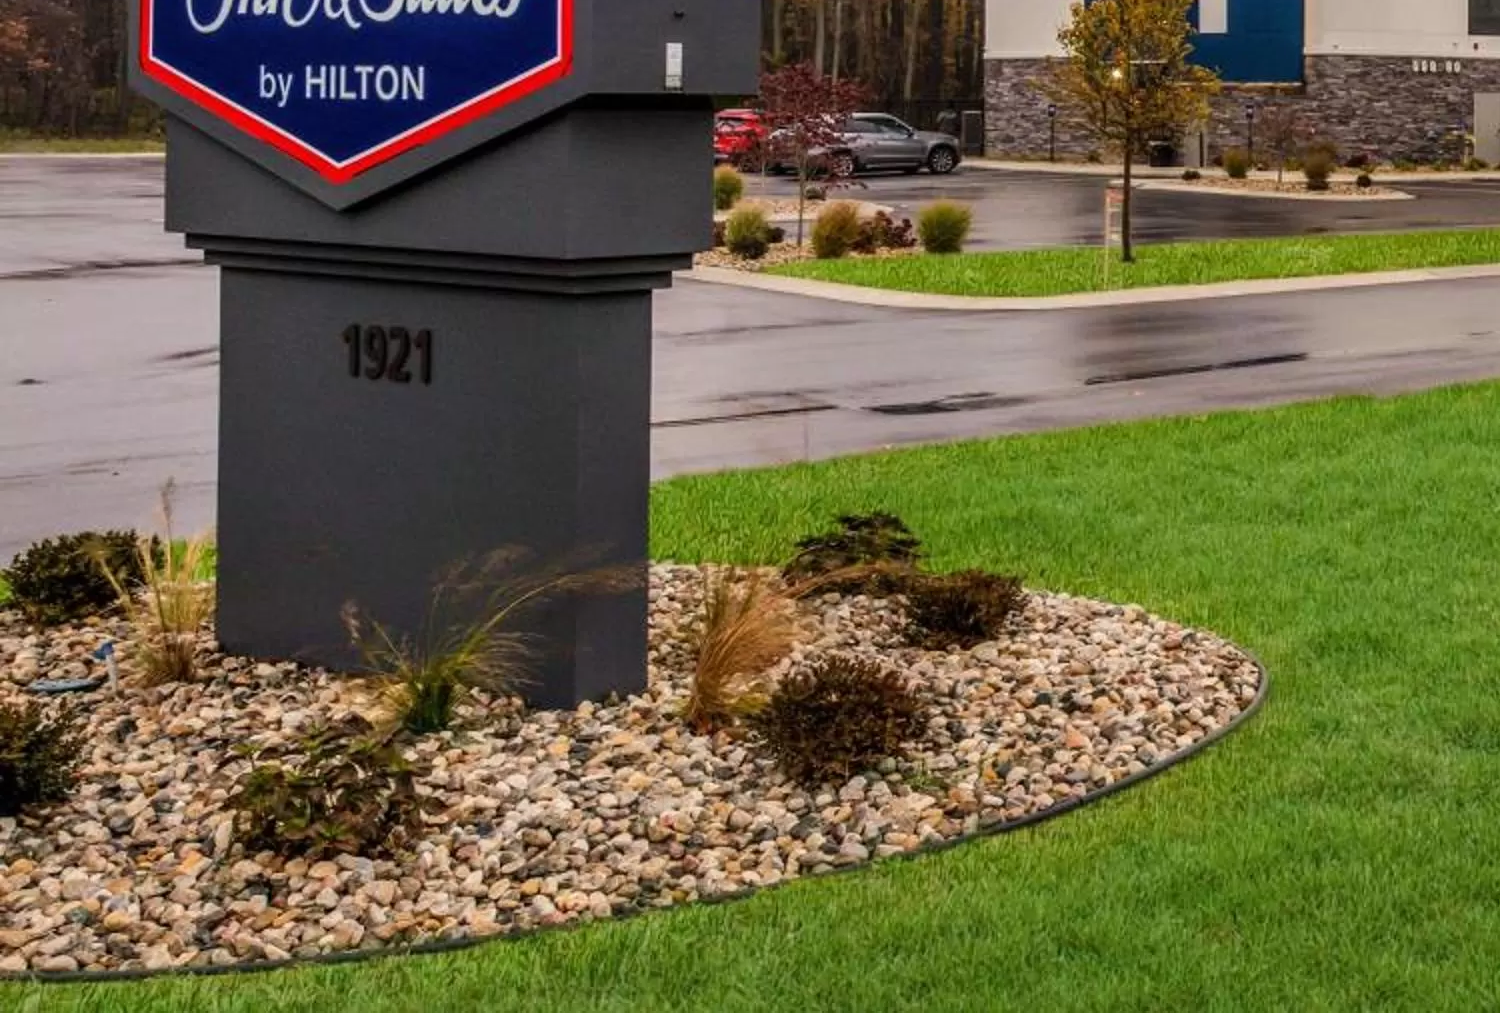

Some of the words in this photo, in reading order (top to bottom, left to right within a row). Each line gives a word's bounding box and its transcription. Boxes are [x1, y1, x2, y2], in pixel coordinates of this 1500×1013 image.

[259, 65, 293, 108] by
[305, 65, 425, 101] HILTON
[341, 322, 434, 388] 1921
